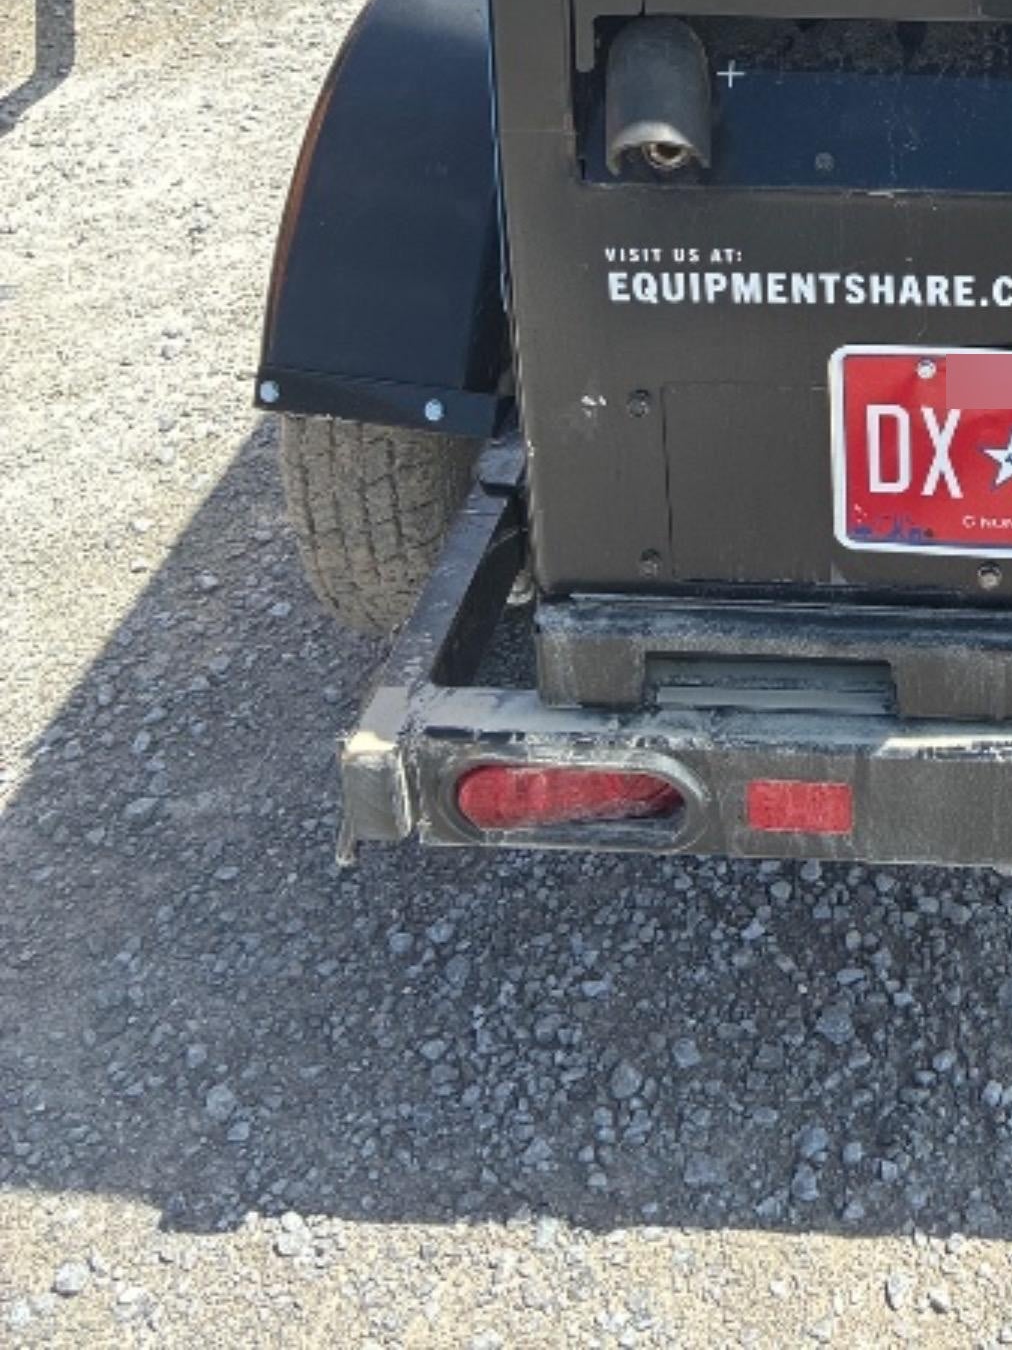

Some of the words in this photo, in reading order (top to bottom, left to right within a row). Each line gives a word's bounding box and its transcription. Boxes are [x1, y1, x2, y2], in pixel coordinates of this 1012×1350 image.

[604, 248, 661, 263] VISIT
[673, 249, 699, 263] US
[710, 249, 743, 263] AT:
[866, 404, 963, 498] DX
